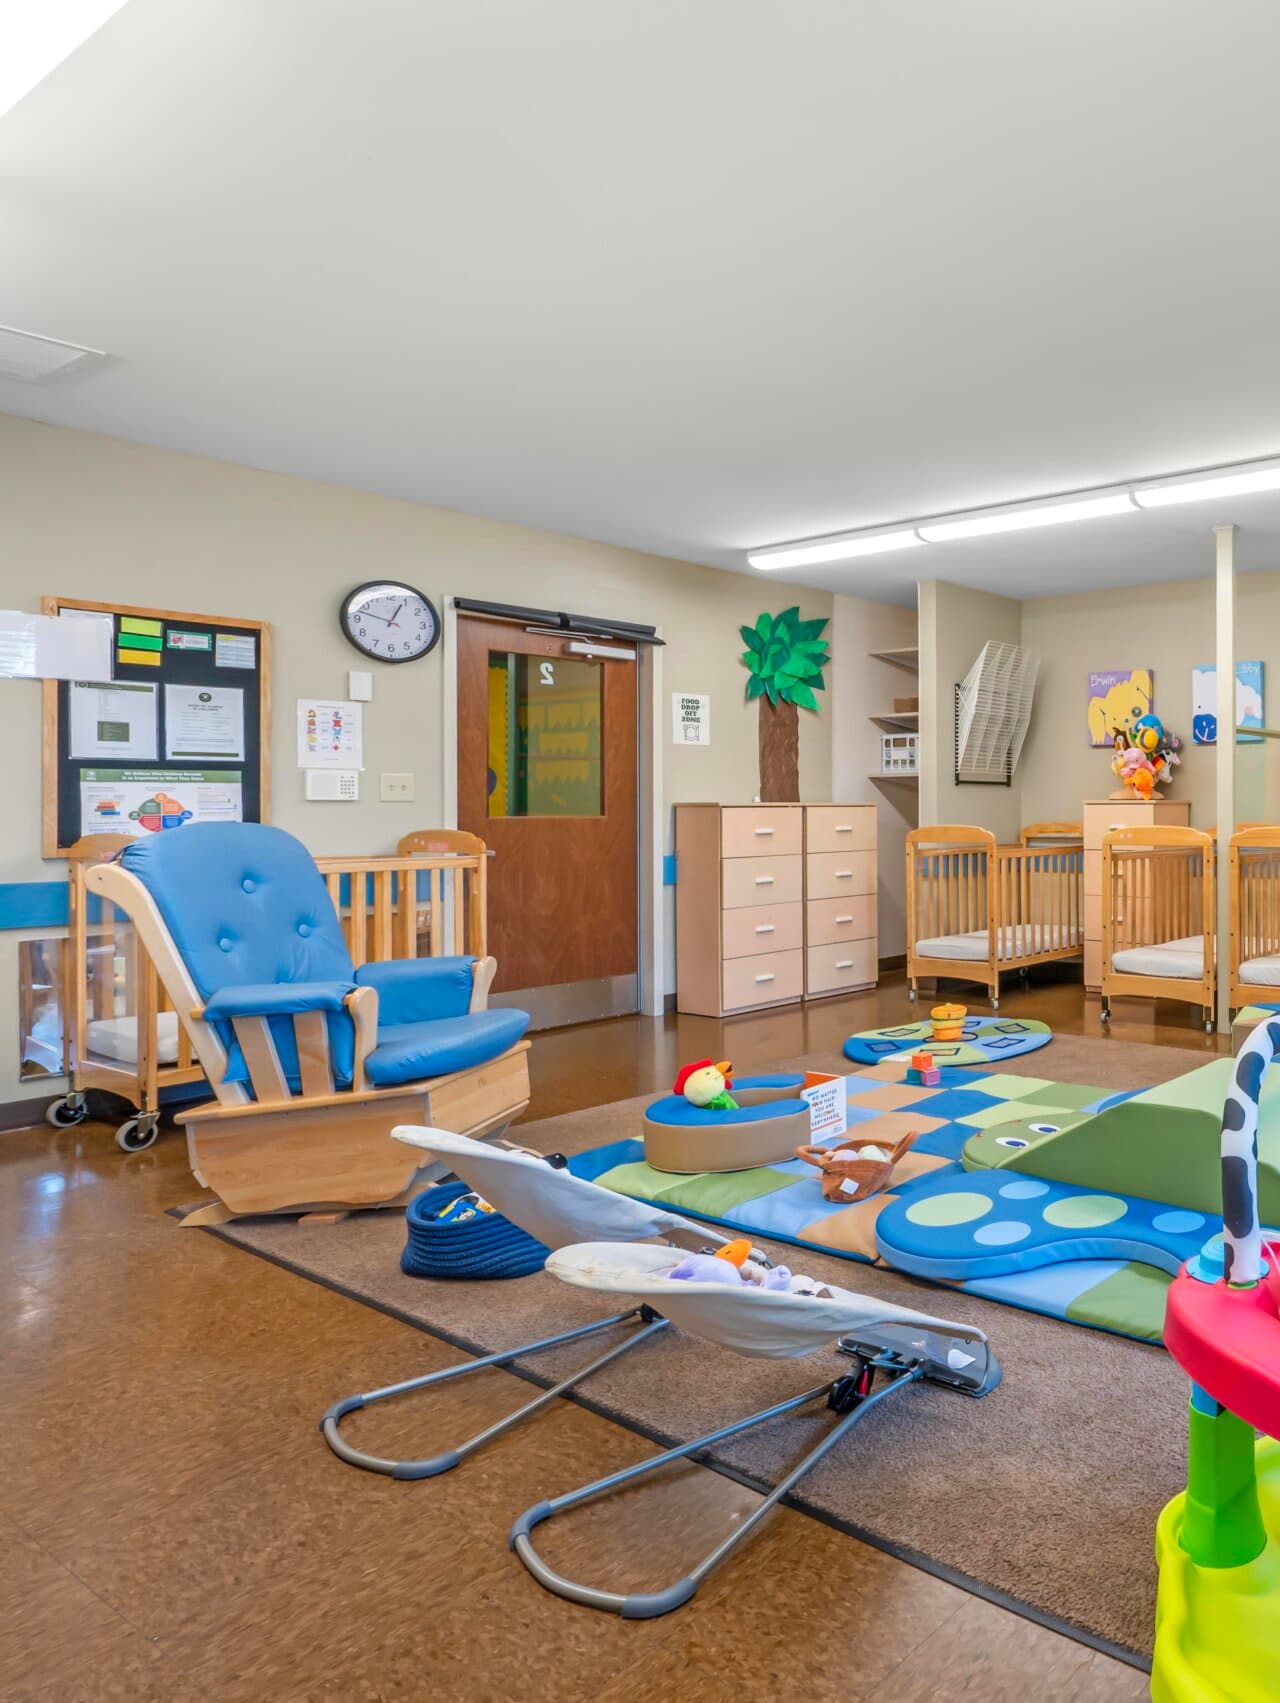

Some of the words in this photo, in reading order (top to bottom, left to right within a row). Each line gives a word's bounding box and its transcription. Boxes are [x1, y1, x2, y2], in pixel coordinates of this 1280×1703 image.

[414, 607, 422, 617] 2
[354, 614, 361, 623] 9
[419, 621, 427, 630] 3
[360, 628, 367, 637] 8
[415, 633, 422, 641] 4
[372, 640, 380, 648] 7
[388, 643, 395, 653] 6
[404, 641, 411, 650] 5
[1090, 674, 1117, 688] Erwin
